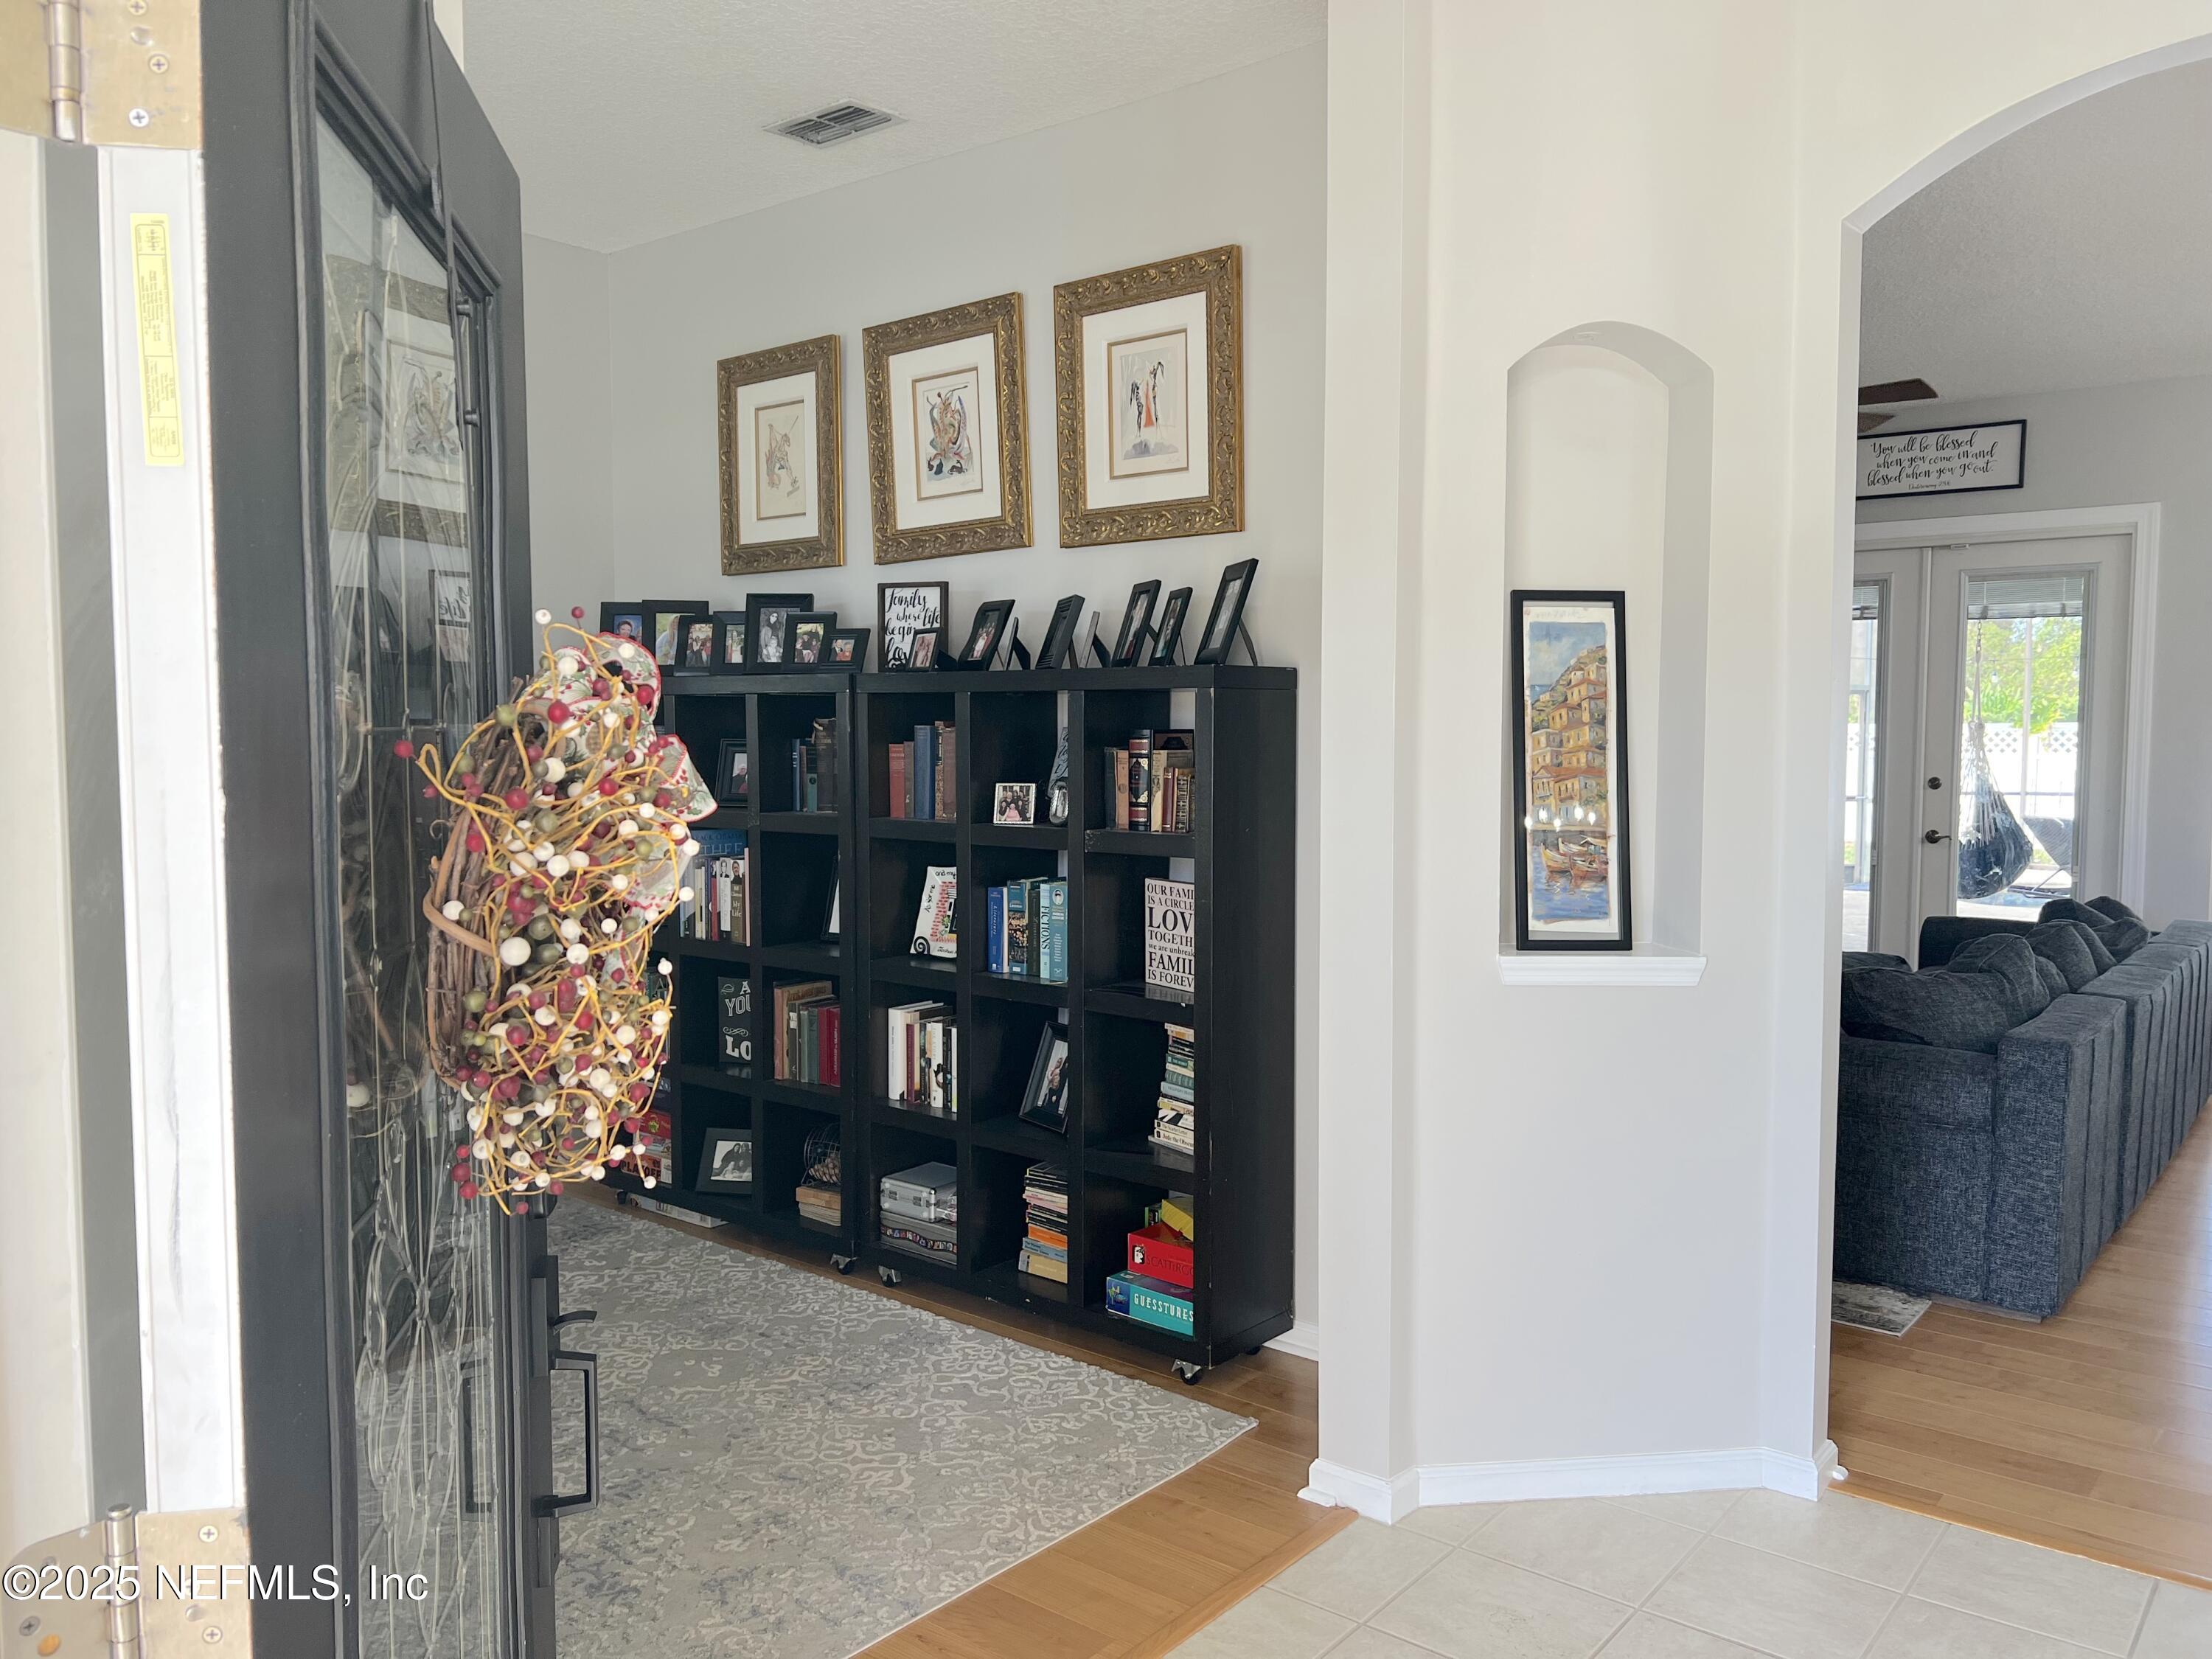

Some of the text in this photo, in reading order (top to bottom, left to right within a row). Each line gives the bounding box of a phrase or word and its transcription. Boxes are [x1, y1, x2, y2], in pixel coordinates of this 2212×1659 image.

[1898, 437, 1916, 453] will
[1919, 436, 1932, 452] be
[1936, 431, 1978, 451] blessed
[1877, 442, 1999, 469] when you come in and
[1868, 467, 1905, 487] blessed
[1906, 465, 1933, 479] when
[1936, 467, 1956, 477] you
[1959, 463, 1973, 477] go
[897, 607, 940, 627] where life
[885, 618, 916, 642] begin
[1147, 883, 1194, 900] OUR FAMI
[1147, 896, 1194, 911] IS A CIRCLE
[1041, 905, 1050, 950] FICTIONS
[1147, 907, 1193, 933] LOV
[1148, 930, 1194, 947] TOGETH
[1169, 947, 1194, 957] unbreak
[1149, 952, 1194, 975] FAMIL
[740, 981, 751, 995] A
[1148, 970, 1194, 988] IS FOREV
[726, 1035, 751, 1060] LO
[1147, 1256, 1194, 1276] SCATTERG
[1134, 1293, 1194, 1322] GUESSTURES
